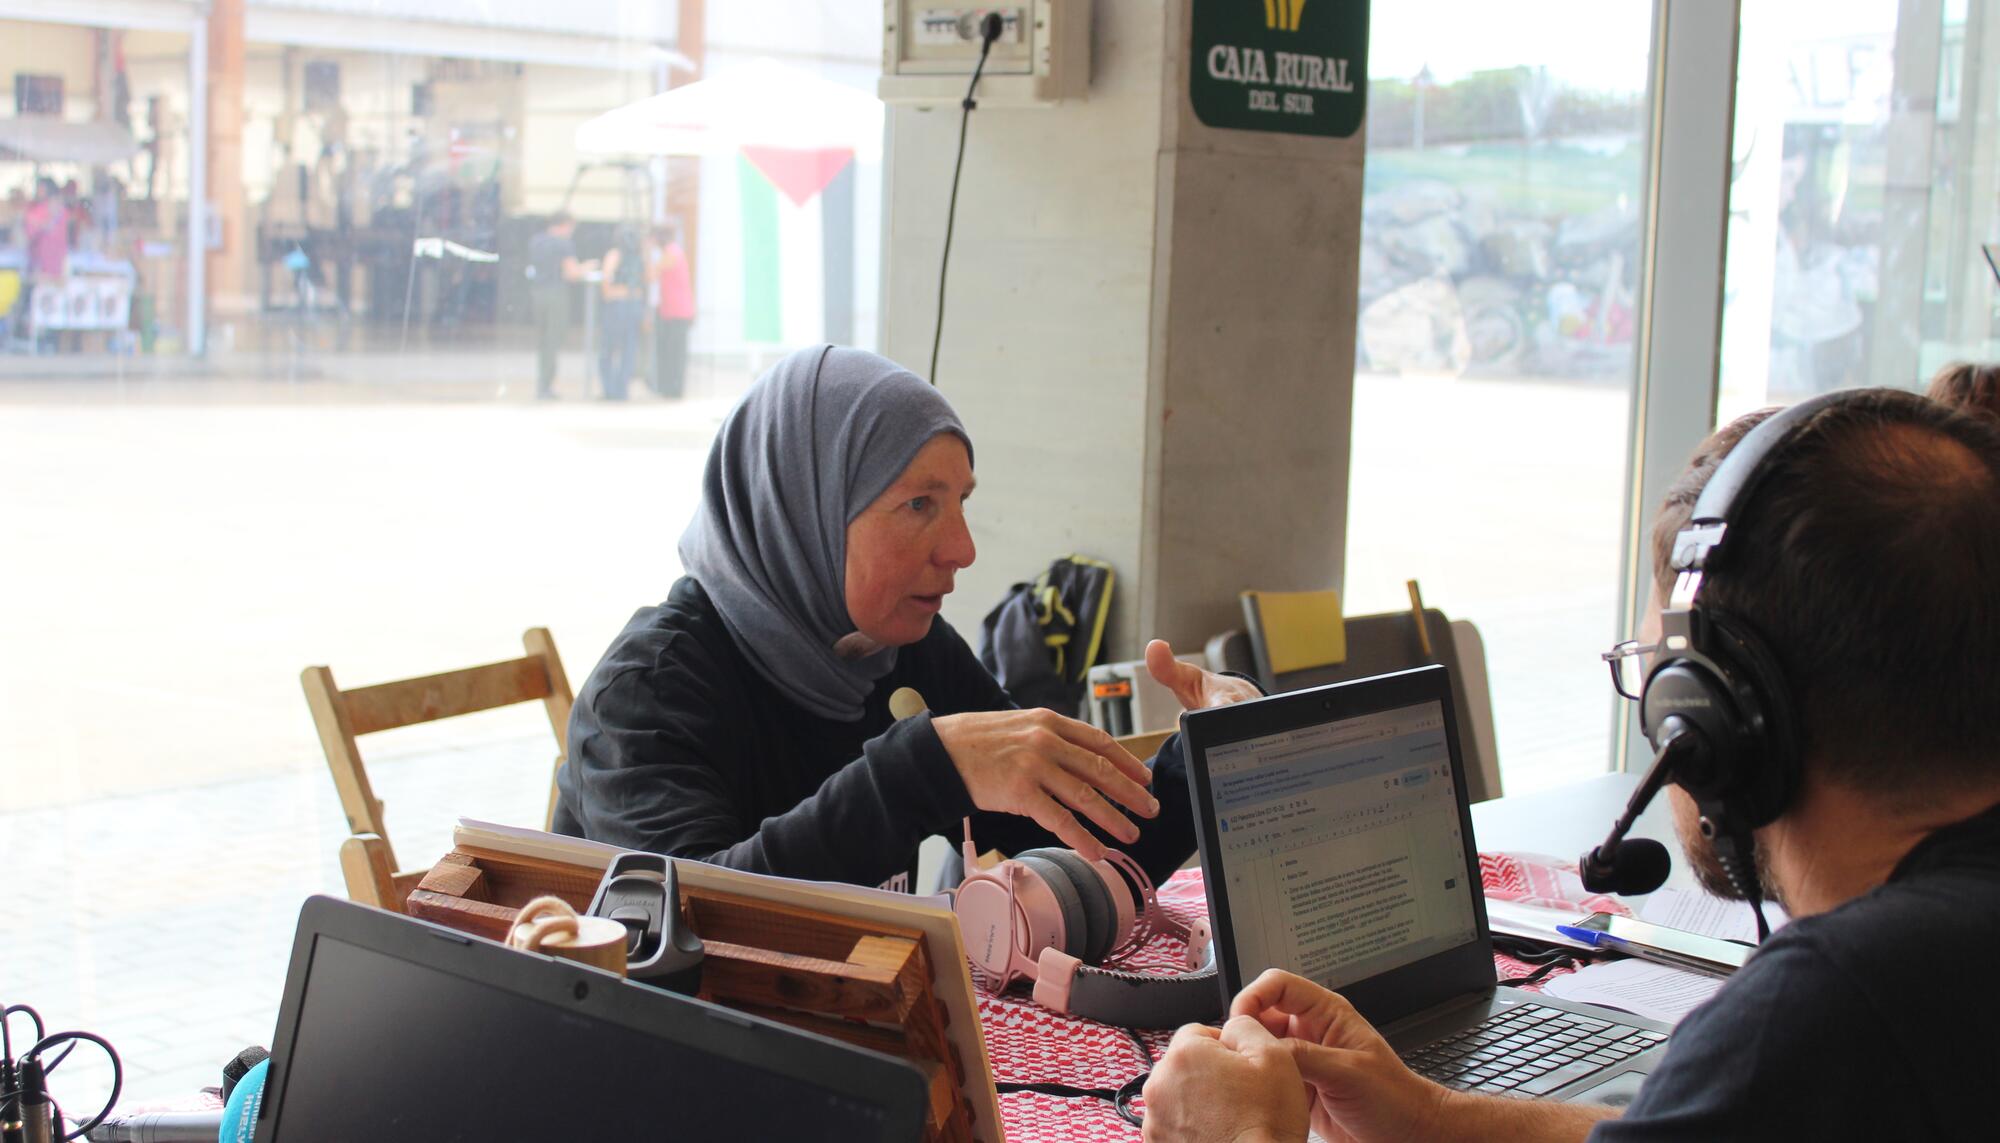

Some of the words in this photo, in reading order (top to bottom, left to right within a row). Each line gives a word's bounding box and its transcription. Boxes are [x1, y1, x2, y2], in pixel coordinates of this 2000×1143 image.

[1207, 44, 1270, 84] CAJA
[1274, 51, 1353, 93] RURAL
[1248, 89, 1280, 112] DEL
[1283, 94, 1314, 115] SUR
